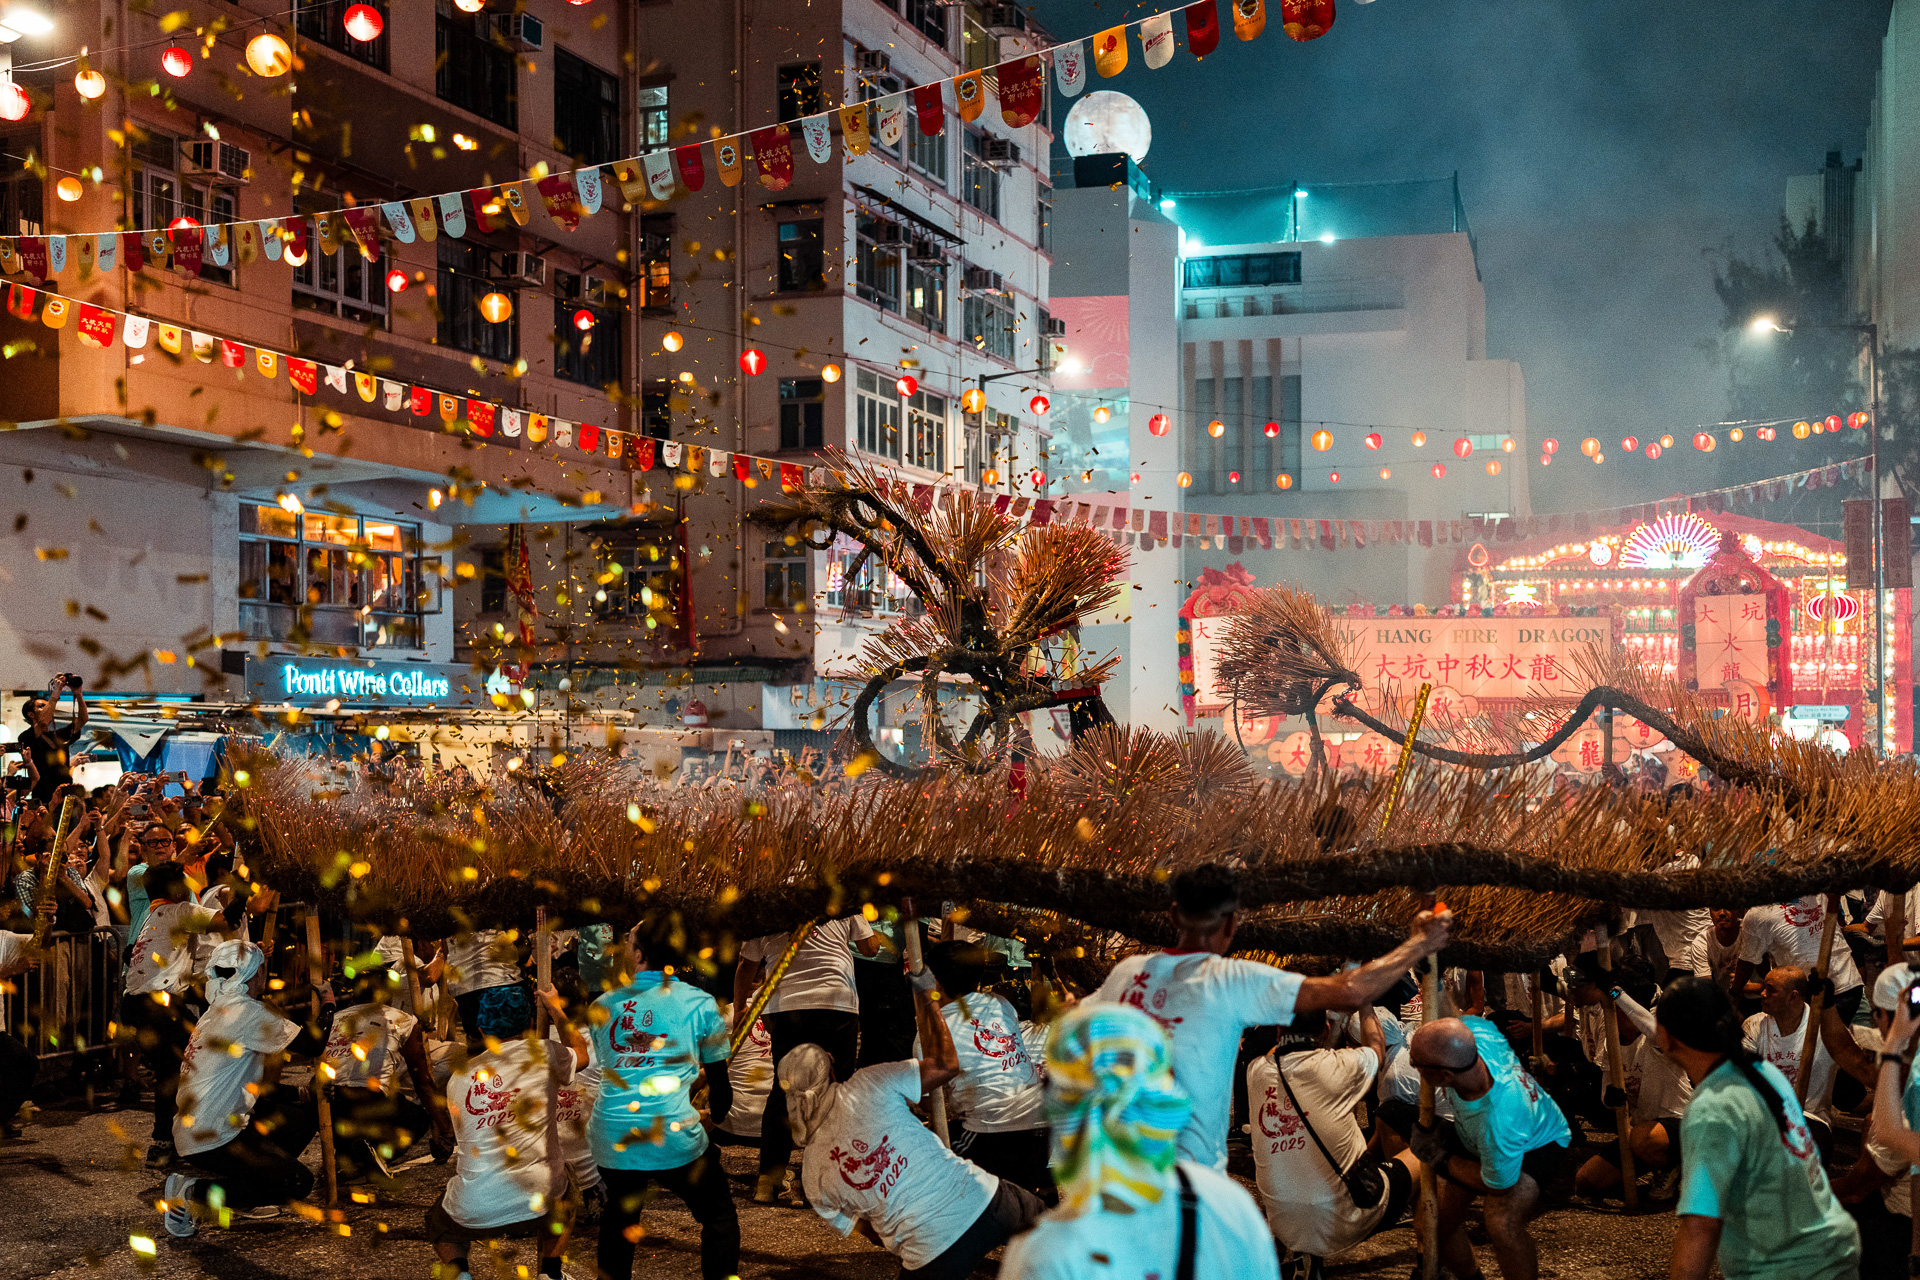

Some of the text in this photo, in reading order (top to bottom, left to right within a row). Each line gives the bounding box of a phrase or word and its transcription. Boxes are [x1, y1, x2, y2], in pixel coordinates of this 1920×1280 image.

[1008, 89, 1035, 103] 賀中秋
[1196, 622, 1212, 639] 大
[1627, 612, 1678, 630] TAI HA
[1376, 629, 1432, 644] HANG
[1452, 629, 1498, 644] FIRE
[1518, 628, 1605, 644] DRAGON
[1722, 632, 1743, 652] 火
[1373, 653, 1559, 684] 大坑中秋火龍
[1721, 661, 1743, 682] 龍
[338, 670, 386, 695] Wine
[390, 670, 449, 696] Cellars
[1430, 696, 1455, 719] 秋
[1735, 692, 1752, 718] 月
[1287, 744, 1307, 767] 大
[1364, 743, 1388, 766] 坑
[1579, 740, 1604, 767] 龍
[1678, 753, 1692, 777] 大坑
[1808, 921, 1824, 936] 202
[620, 1000, 637, 1030] 火龍
[326, 1048, 352, 1058] 2025
[614, 1056, 655, 1069] 2025
[1002, 1051, 1031, 1071] 2025
[1265, 1086, 1279, 1117] 火龍
[476, 1111, 516, 1130] 2025
[556, 1109, 581, 1122] 025
[1271, 1136, 1306, 1154] 2025
[829, 1146, 861, 1174] 火龍
[880, 1154, 908, 1198] 2025
